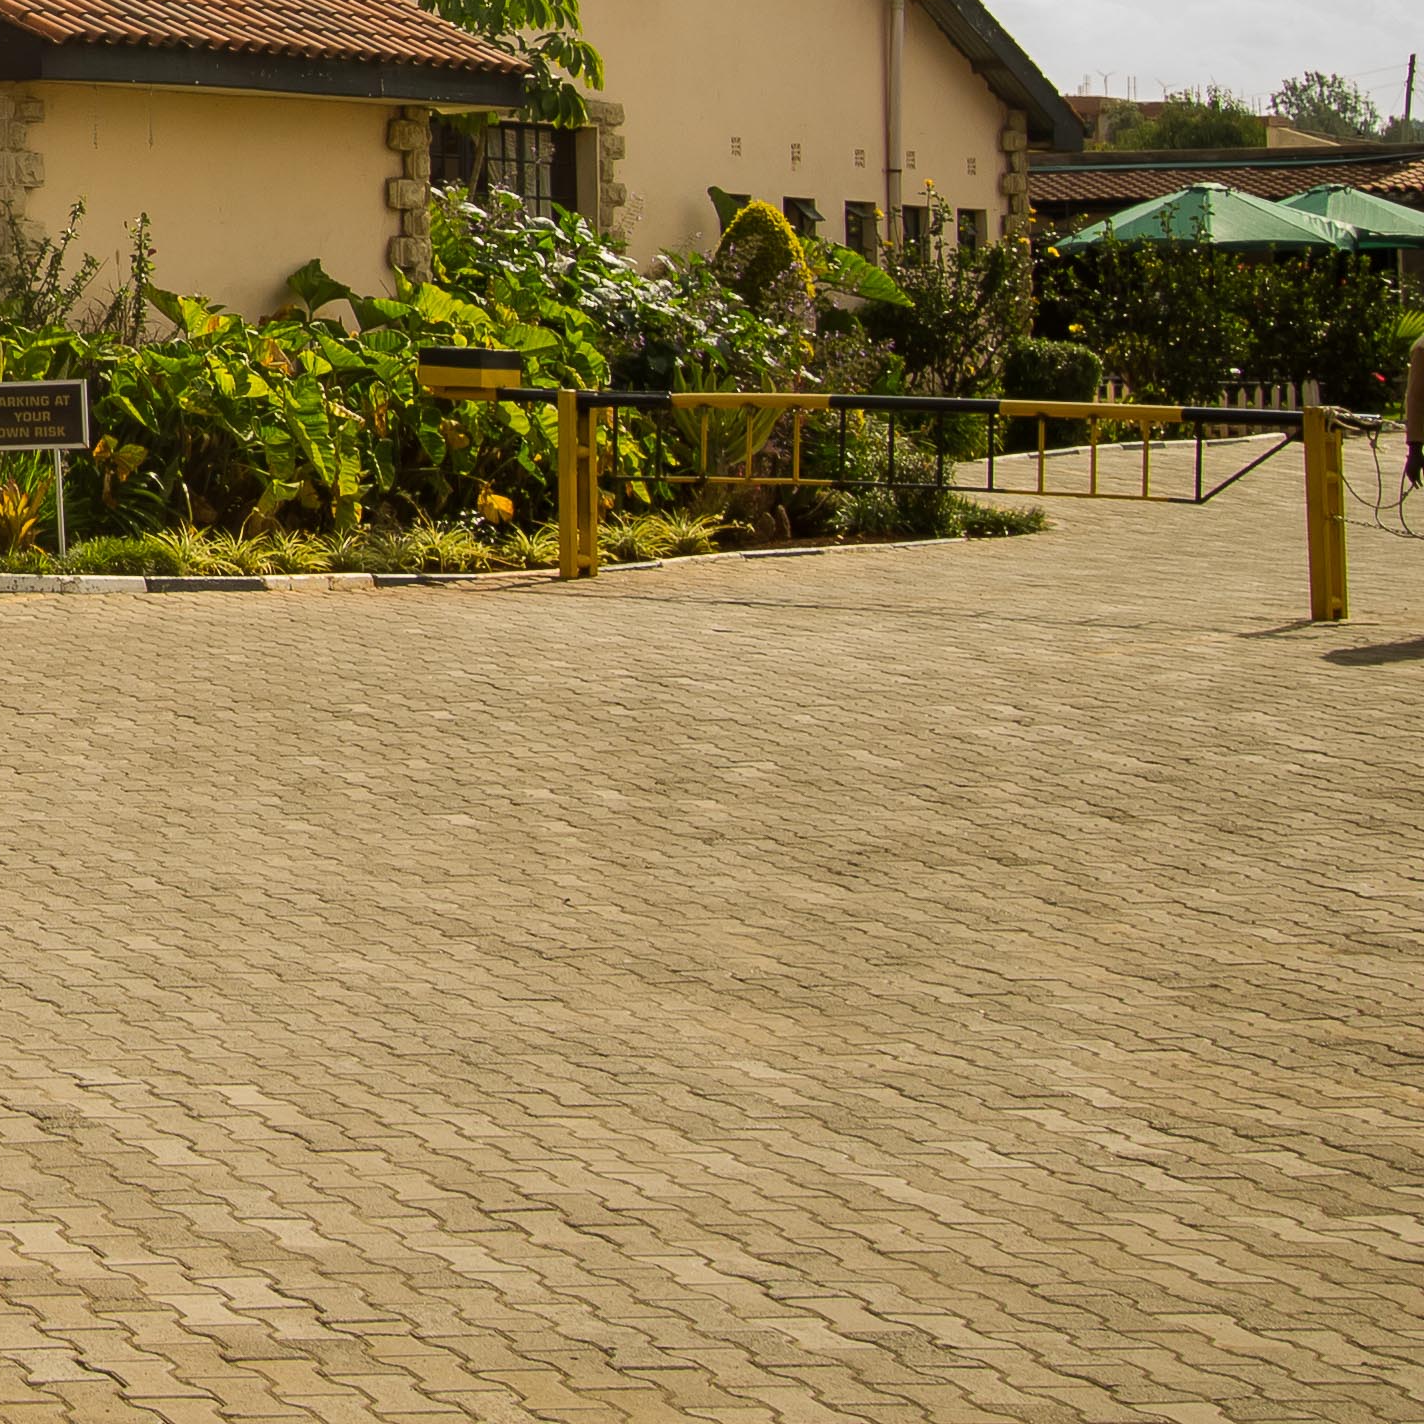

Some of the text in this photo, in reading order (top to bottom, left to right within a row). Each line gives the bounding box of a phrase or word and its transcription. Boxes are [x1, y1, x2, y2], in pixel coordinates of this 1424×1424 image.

[54, 395, 71, 407] AT
[14, 411, 51, 423] YOUR
[34, 426, 66, 438] RISK
